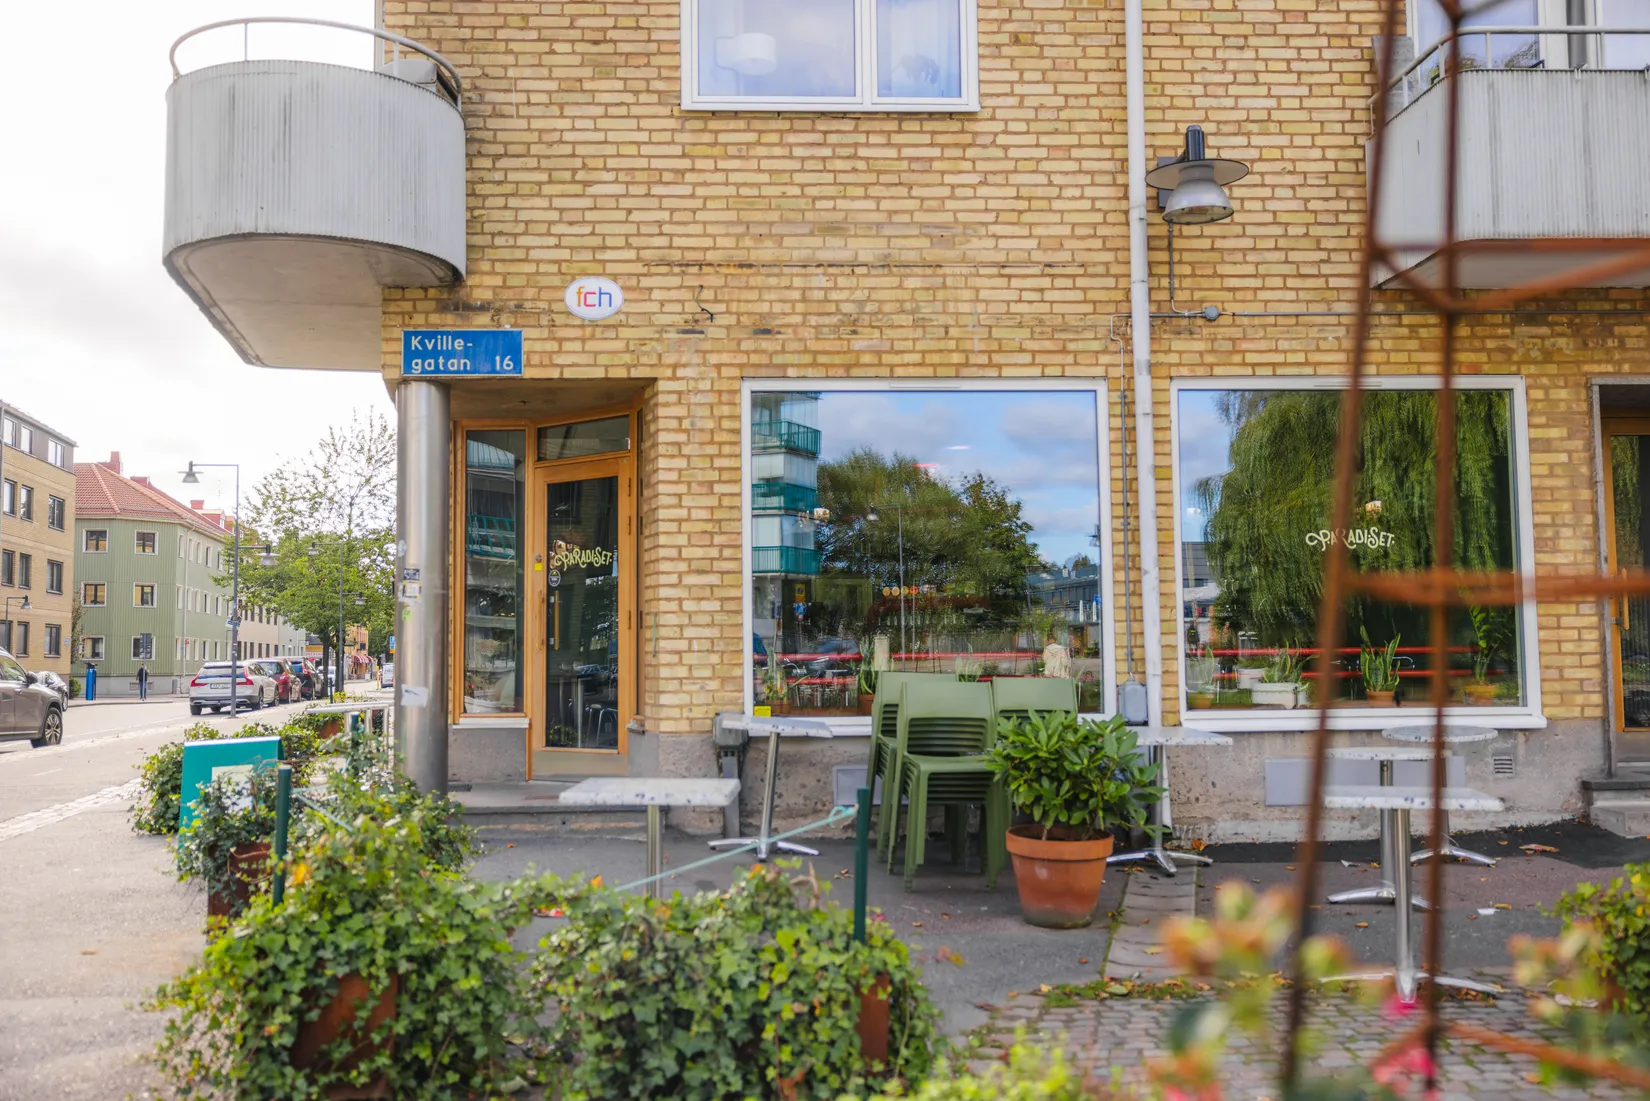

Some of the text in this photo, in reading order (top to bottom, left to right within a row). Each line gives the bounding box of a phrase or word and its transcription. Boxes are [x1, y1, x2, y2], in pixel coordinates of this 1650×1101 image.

[576, 286, 612, 308] fch
[411, 335, 473, 351] Kville-
[411, 355, 514, 374] gatan 16
